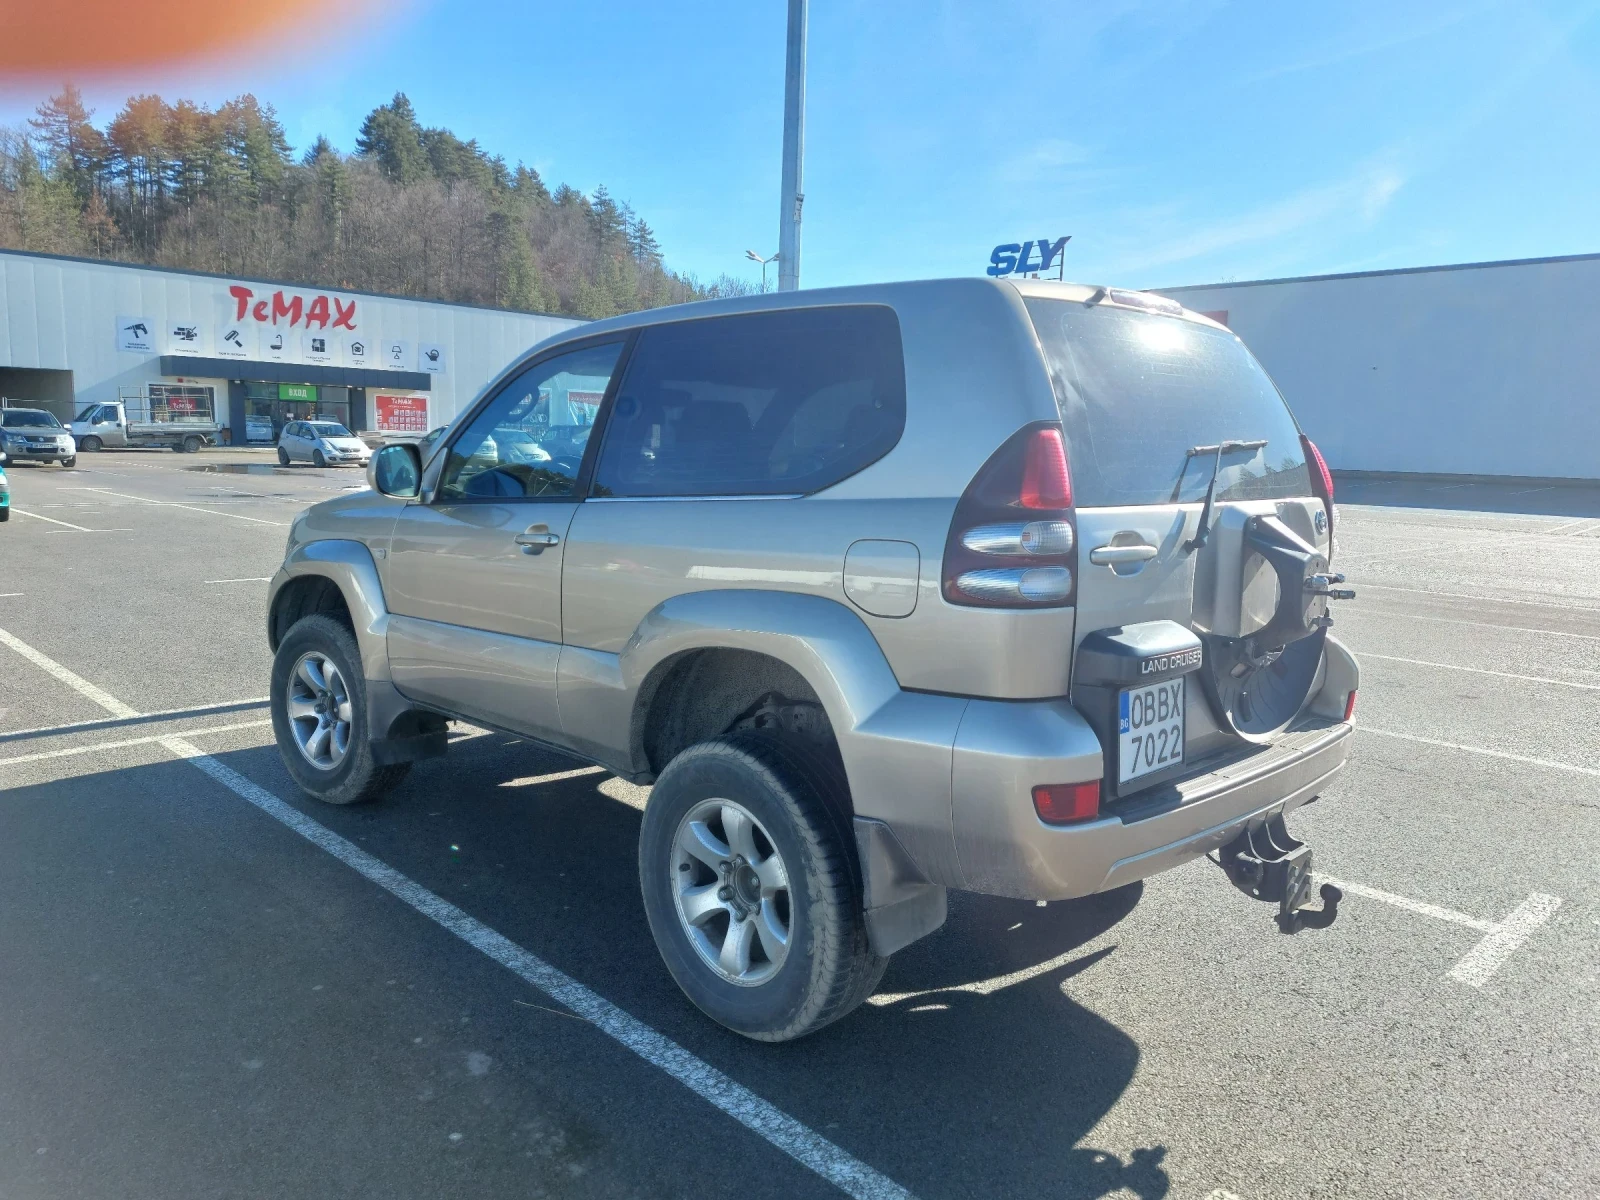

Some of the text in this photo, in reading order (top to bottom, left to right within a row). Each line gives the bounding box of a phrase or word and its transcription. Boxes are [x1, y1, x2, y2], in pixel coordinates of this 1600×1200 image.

[987, 236, 1072, 276] SLY
[229, 285, 357, 330] TeMAX
[288, 388, 308, 398] ВХОД
[1141, 651, 1202, 674] LAND CRUISER
[1120, 718, 1129, 730] BG
[1131, 683, 1181, 729] OBBX
[1131, 724, 1181, 774] 7022
